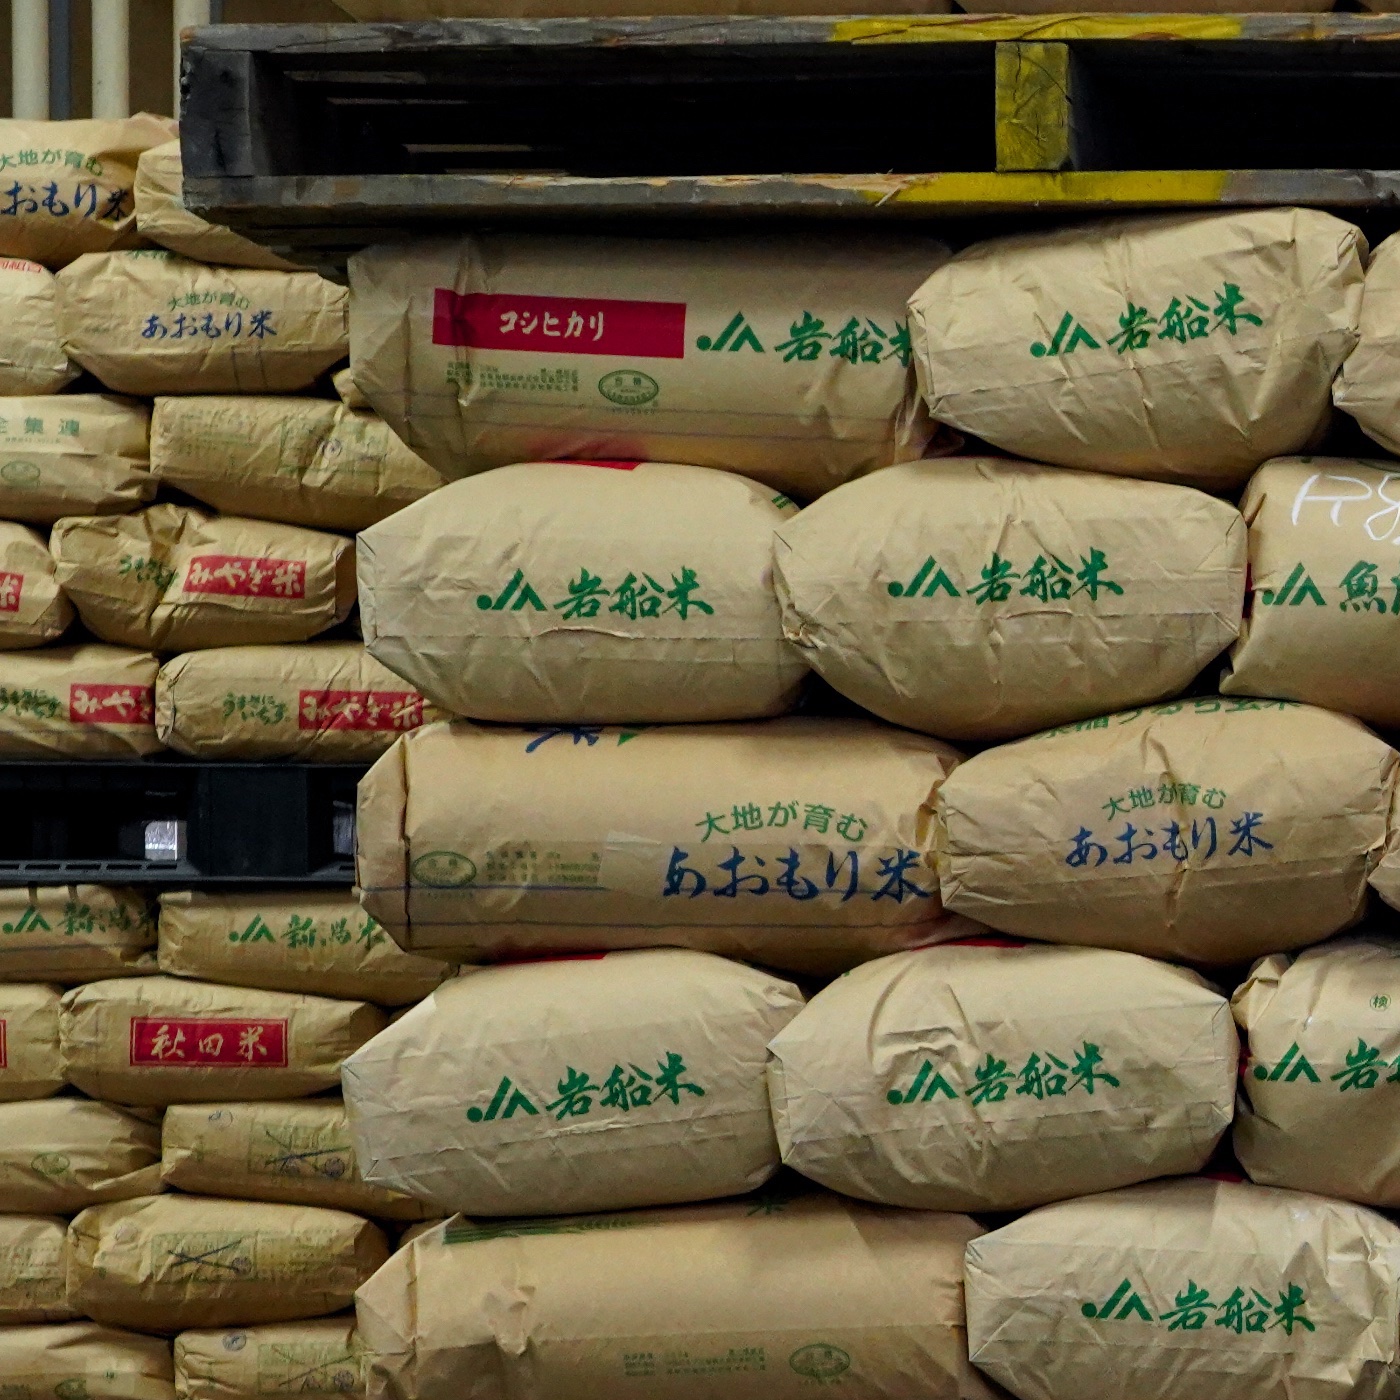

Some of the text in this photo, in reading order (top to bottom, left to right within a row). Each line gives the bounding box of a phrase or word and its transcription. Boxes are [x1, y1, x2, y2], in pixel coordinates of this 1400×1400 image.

[141, 311, 277, 339] あおもり米
[500, 310, 605, 342] コシヒカリ
[1106, 283, 1264, 355] 岩船米
[190, 559, 303, 598] みやぎ米
[553, 566, 715, 621] 岩船米
[966, 546, 1124, 604] 岩船米
[302, 694, 421, 729] みやぎ米
[697, 802, 869, 842] 大地が育む
[1103, 785, 1227, 819] 大地が育む
[1066, 812, 1274, 868] あおもり米
[662, 847, 936, 902] あおもり米
[151, 1024, 268, 1062] 秋田米
[547, 1052, 704, 1121] 岩船米
[966, 1041, 1120, 1106] 岩船米
[1160, 1280, 1316, 1336] 岩船米
